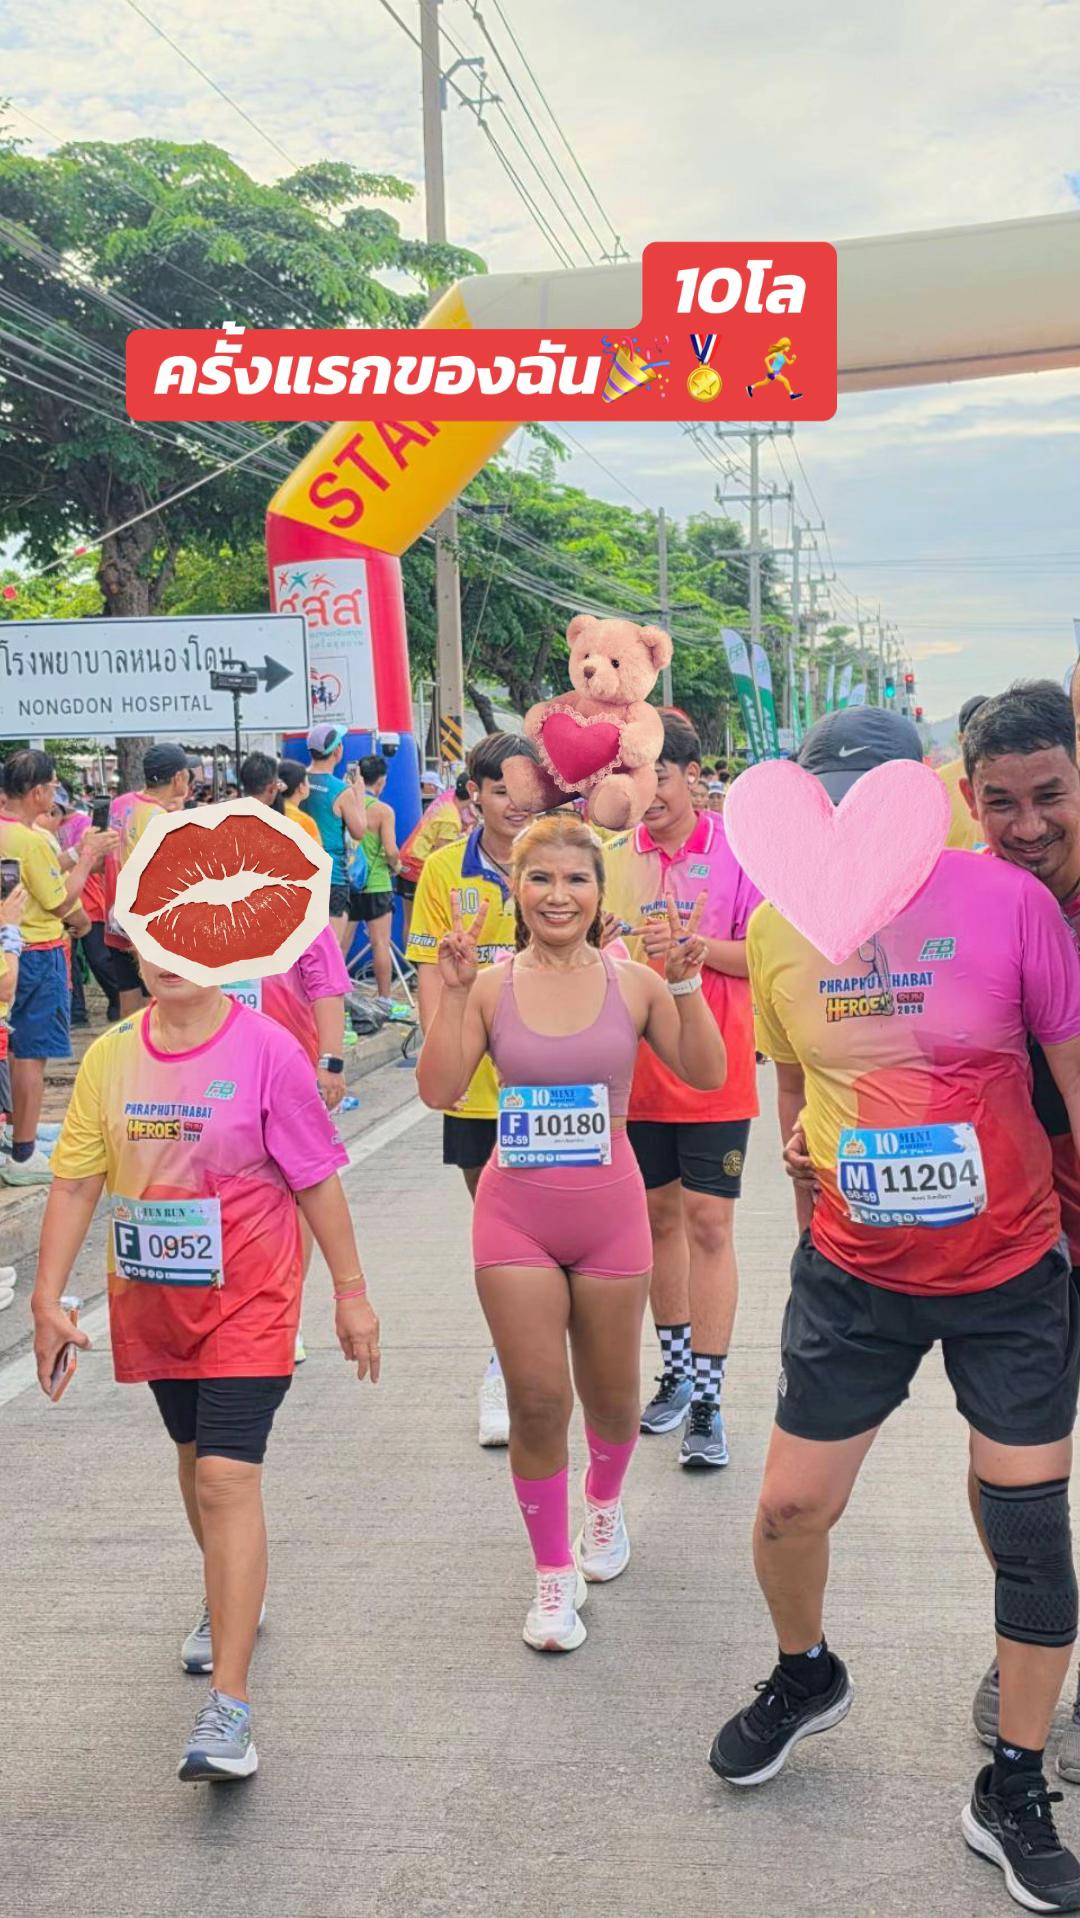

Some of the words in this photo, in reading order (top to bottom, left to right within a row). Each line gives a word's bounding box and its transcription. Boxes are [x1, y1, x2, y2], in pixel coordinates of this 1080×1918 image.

[308, 420, 441, 529] STA
[18, 699, 113, 716] NONGDON
[121, 695, 213, 713] HOSPITAL
[531, 1089, 550, 1106] 10
[127, 1119, 181, 1140] HEROES
[509, 1114, 521, 1134] F
[534, 1112, 606, 1136] 10180
[502, 1135, 529, 1145] 50-59
[875, 1132, 899, 1154] 10
[845, 1165, 870, 1190] M
[881, 1159, 980, 1193] 11204
[164, 1207, 186, 1218] RUN
[118, 1226, 134, 1255] F
[148, 1233, 213, 1260] 0952
